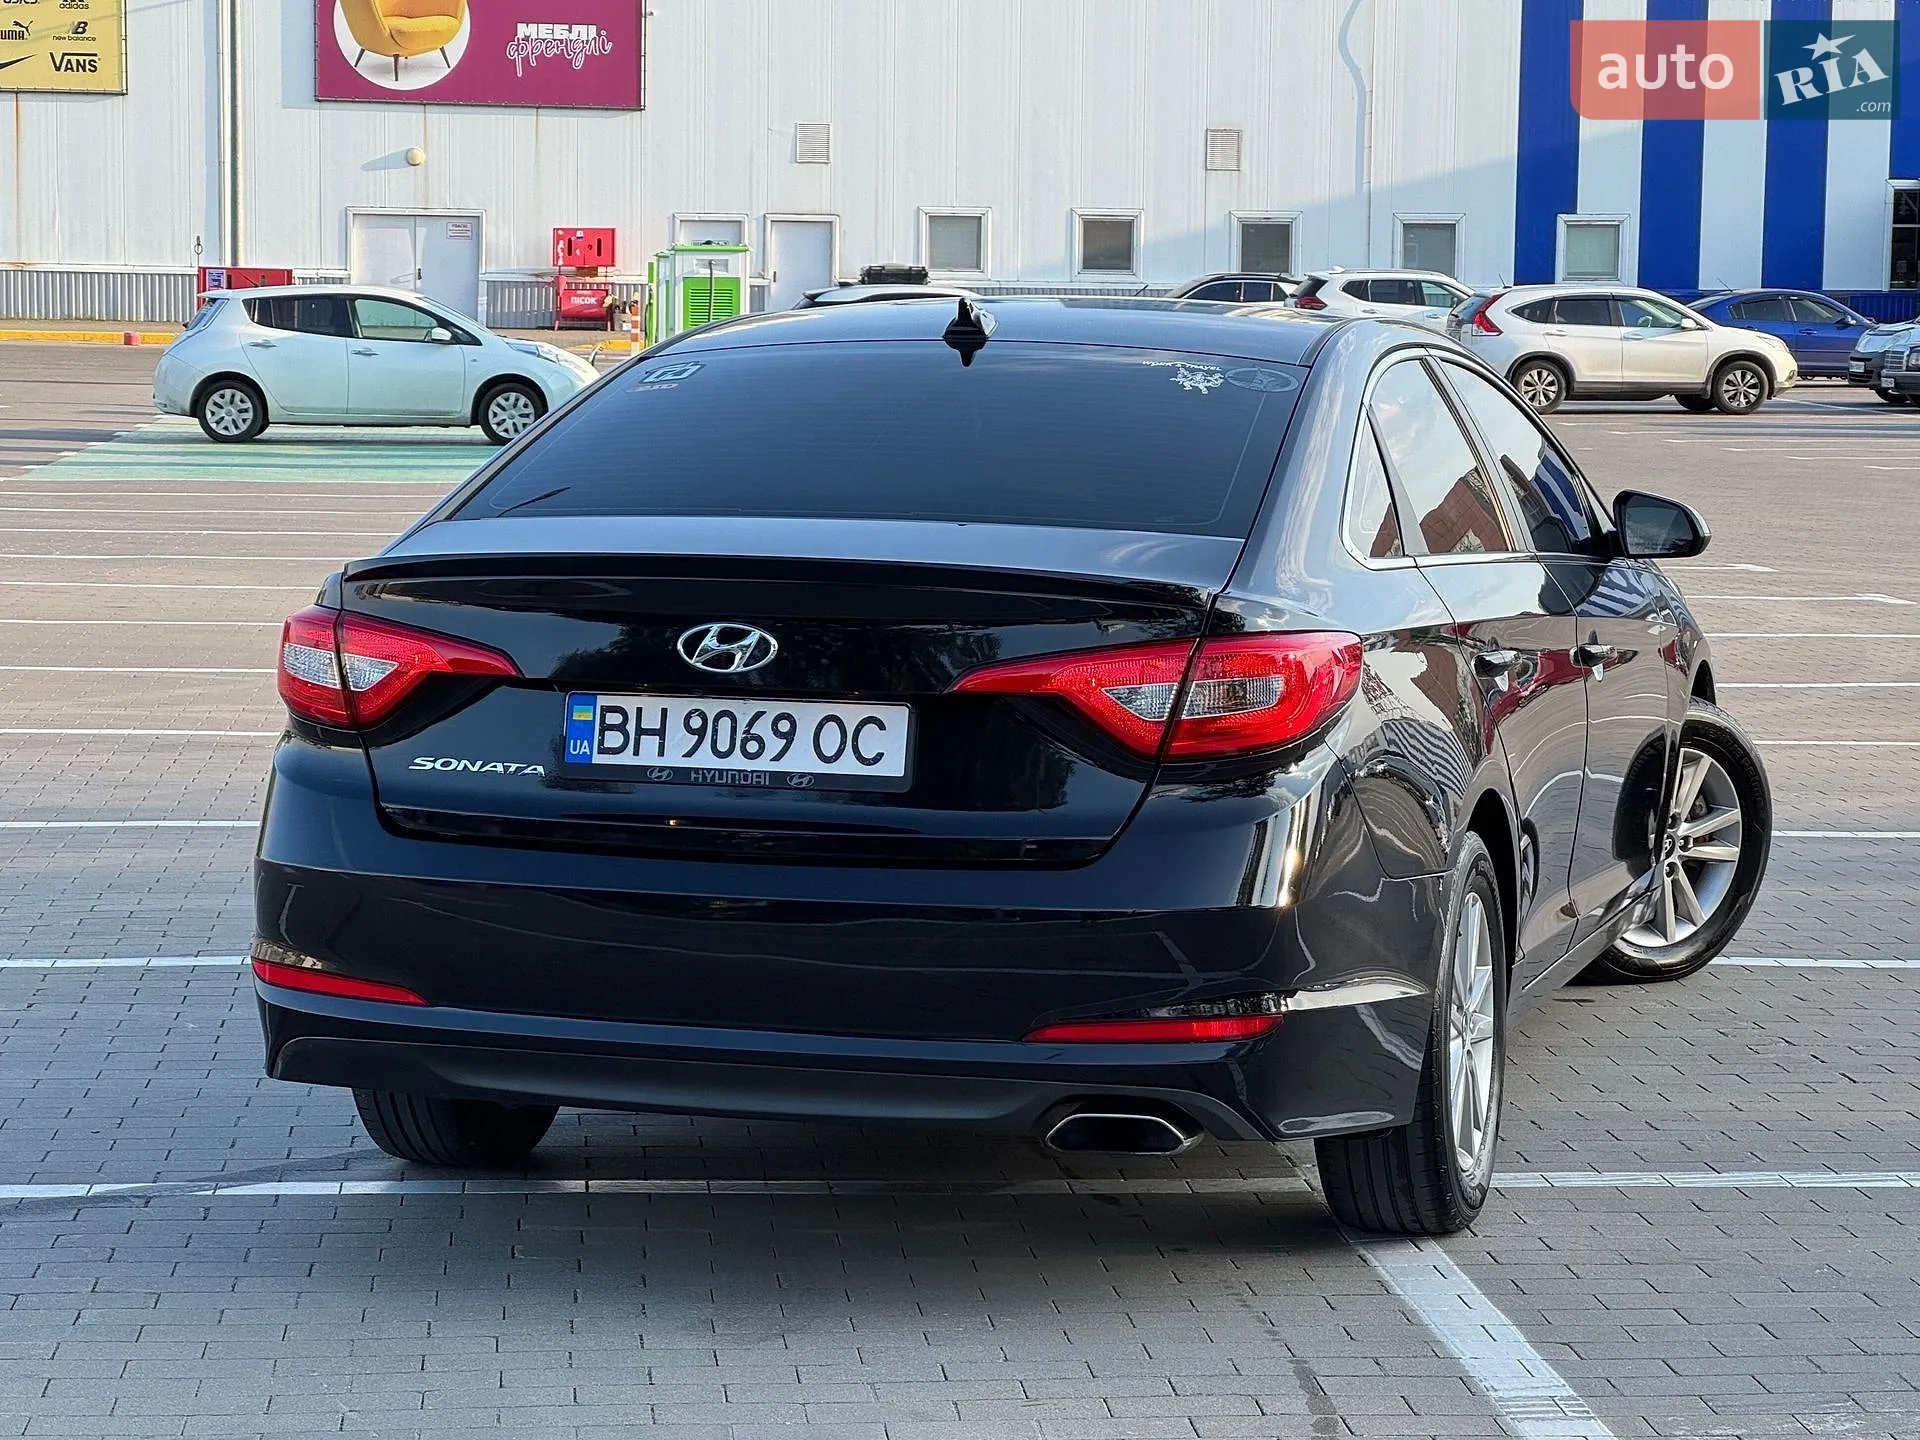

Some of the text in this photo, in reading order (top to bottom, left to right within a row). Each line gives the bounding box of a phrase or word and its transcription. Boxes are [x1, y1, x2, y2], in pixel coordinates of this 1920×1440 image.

[59, 2, 90, 10] adidas
[0, 30, 24, 40] UMA
[517, 23, 597, 40] МЕБЛІ
[49, 52, 98, 73] VANS
[570, 296, 598, 304] ПІСОК
[596, 705, 887, 767] BH 9069 OC
[570, 739, 591, 755] UA
[408, 756, 546, 777] SONATA
[690, 769, 770, 785] HYUNDAI
